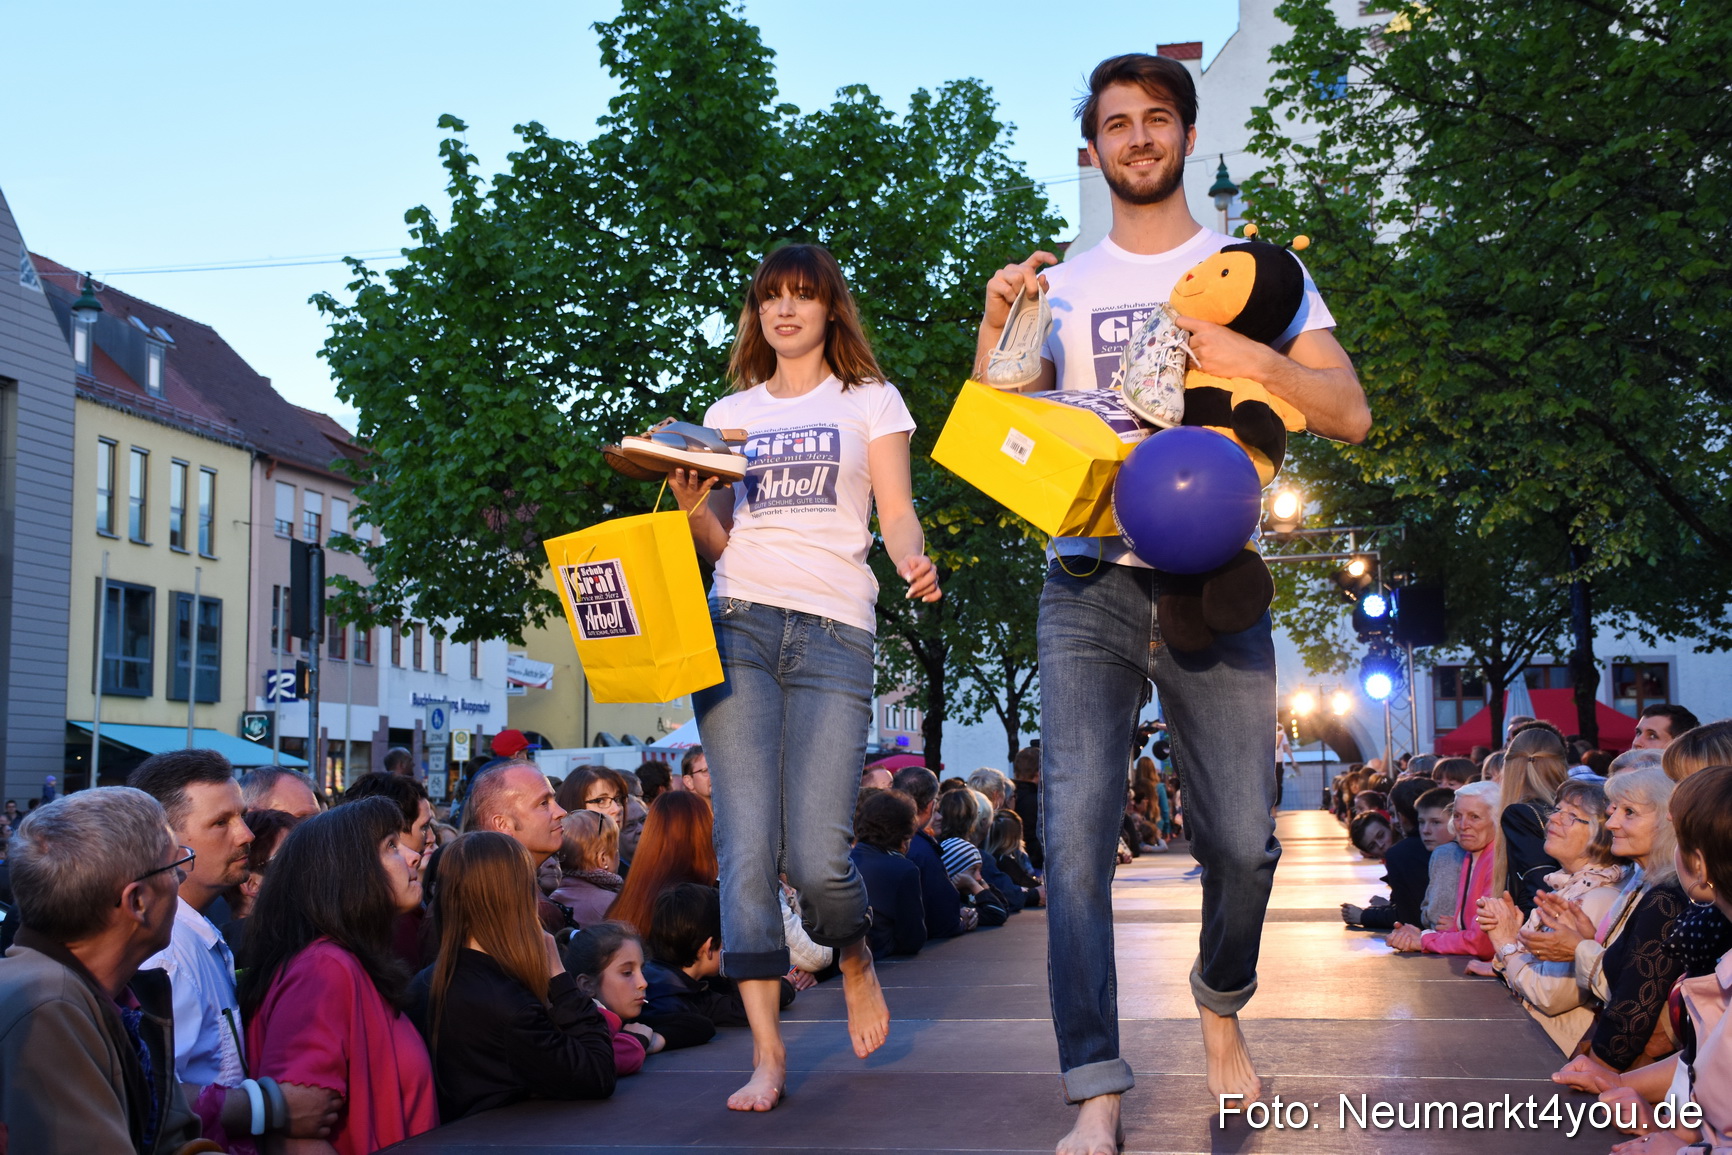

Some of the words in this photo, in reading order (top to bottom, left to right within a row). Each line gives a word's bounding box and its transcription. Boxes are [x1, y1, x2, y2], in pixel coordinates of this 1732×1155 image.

[1132, 310, 1154, 321] Sc
[775, 429, 818, 441] Schuh
[743, 431, 835, 458] Graf
[784, 453, 802, 462] mit
[805, 452, 834, 461] Herz
[755, 465, 830, 502] Arbell
[754, 502, 767, 510] GUTE
[767, 498, 795, 507] SCHUHE,
[796, 497, 814, 505] GUTE
[751, 508, 783, 520] Neumarkt
[790, 506, 837, 515] Kirchengasse
[580, 565, 604, 577] Schuh
[570, 567, 616, 595] Graf
[585, 601, 624, 631] Arbell
